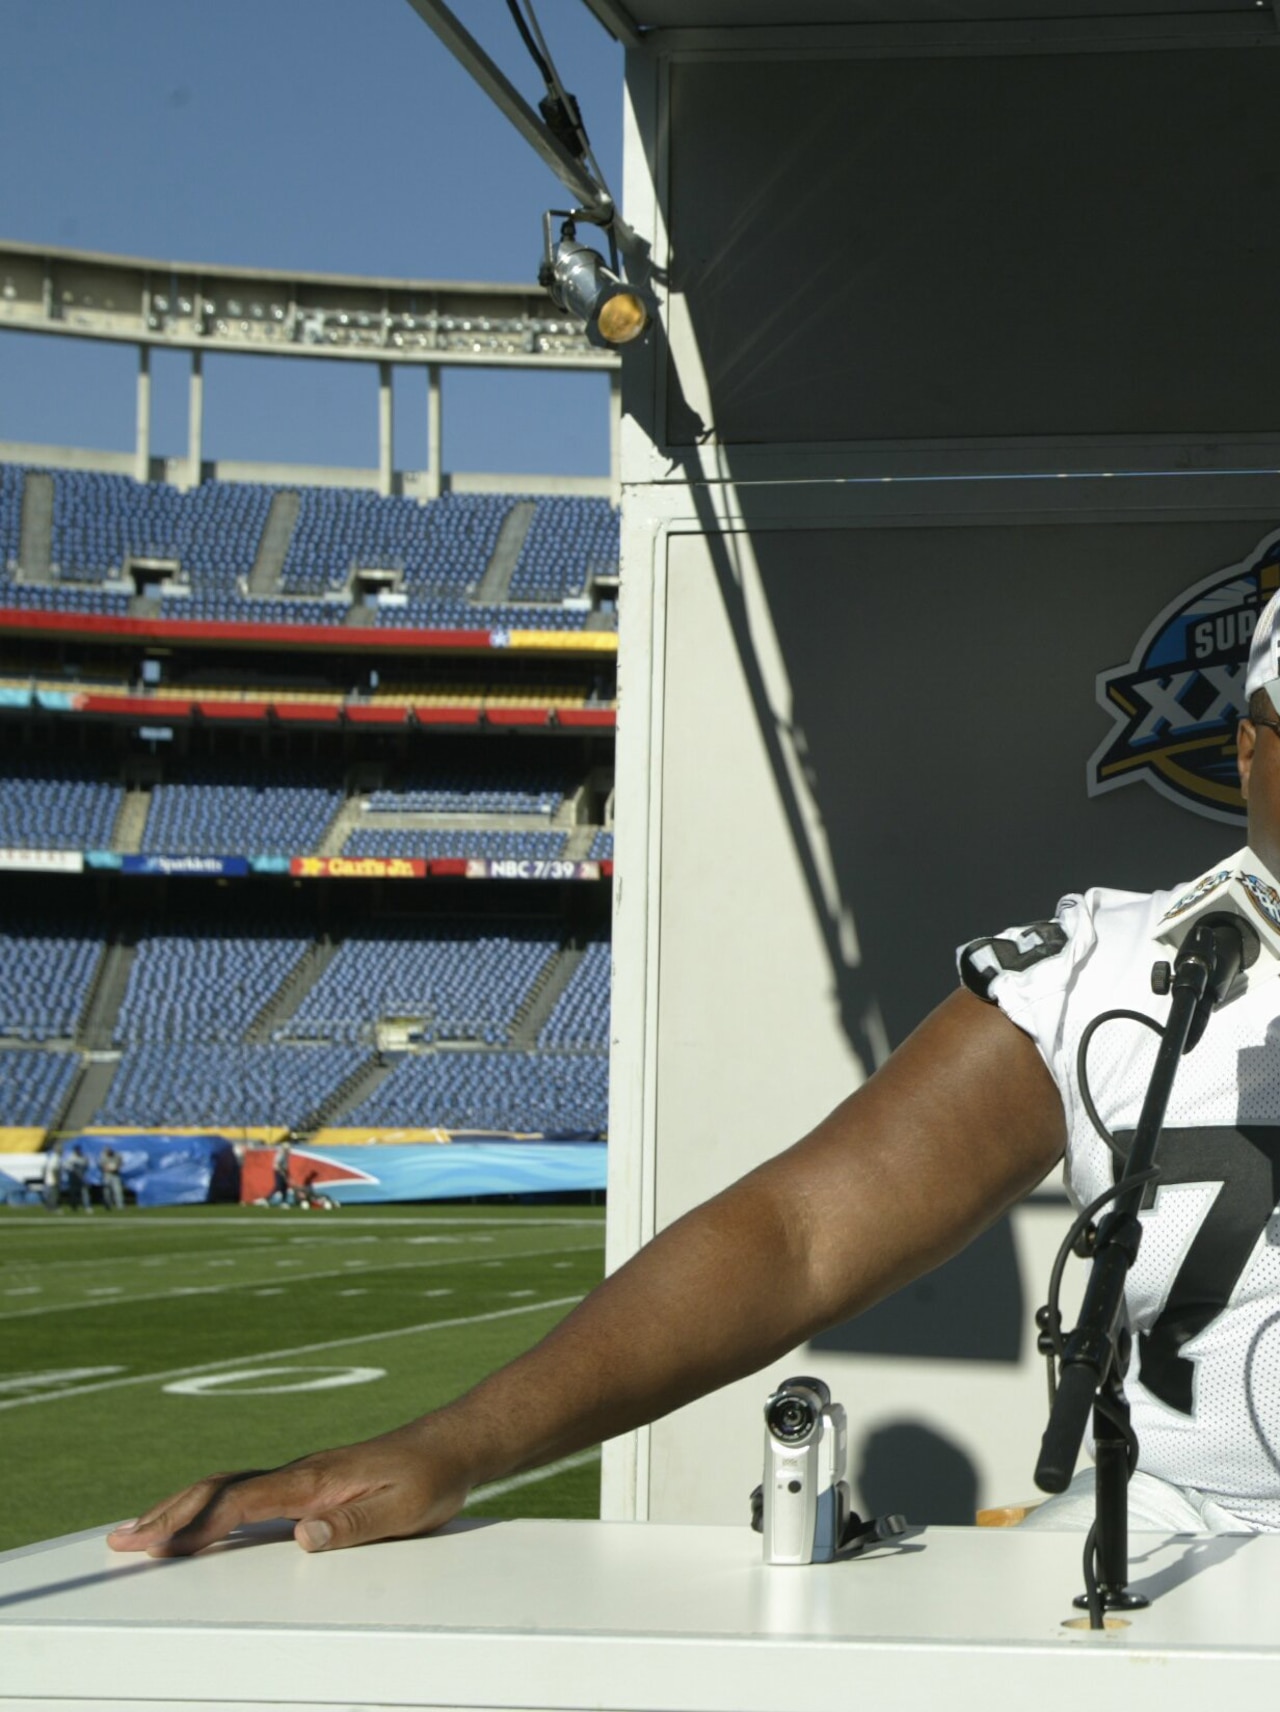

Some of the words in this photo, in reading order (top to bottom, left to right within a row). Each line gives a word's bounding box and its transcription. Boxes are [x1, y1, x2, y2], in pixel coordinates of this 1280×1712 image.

[328, 858, 386, 877] Carl's
[490, 860, 530, 878] NBC
[532, 860, 575, 880] 7/39
